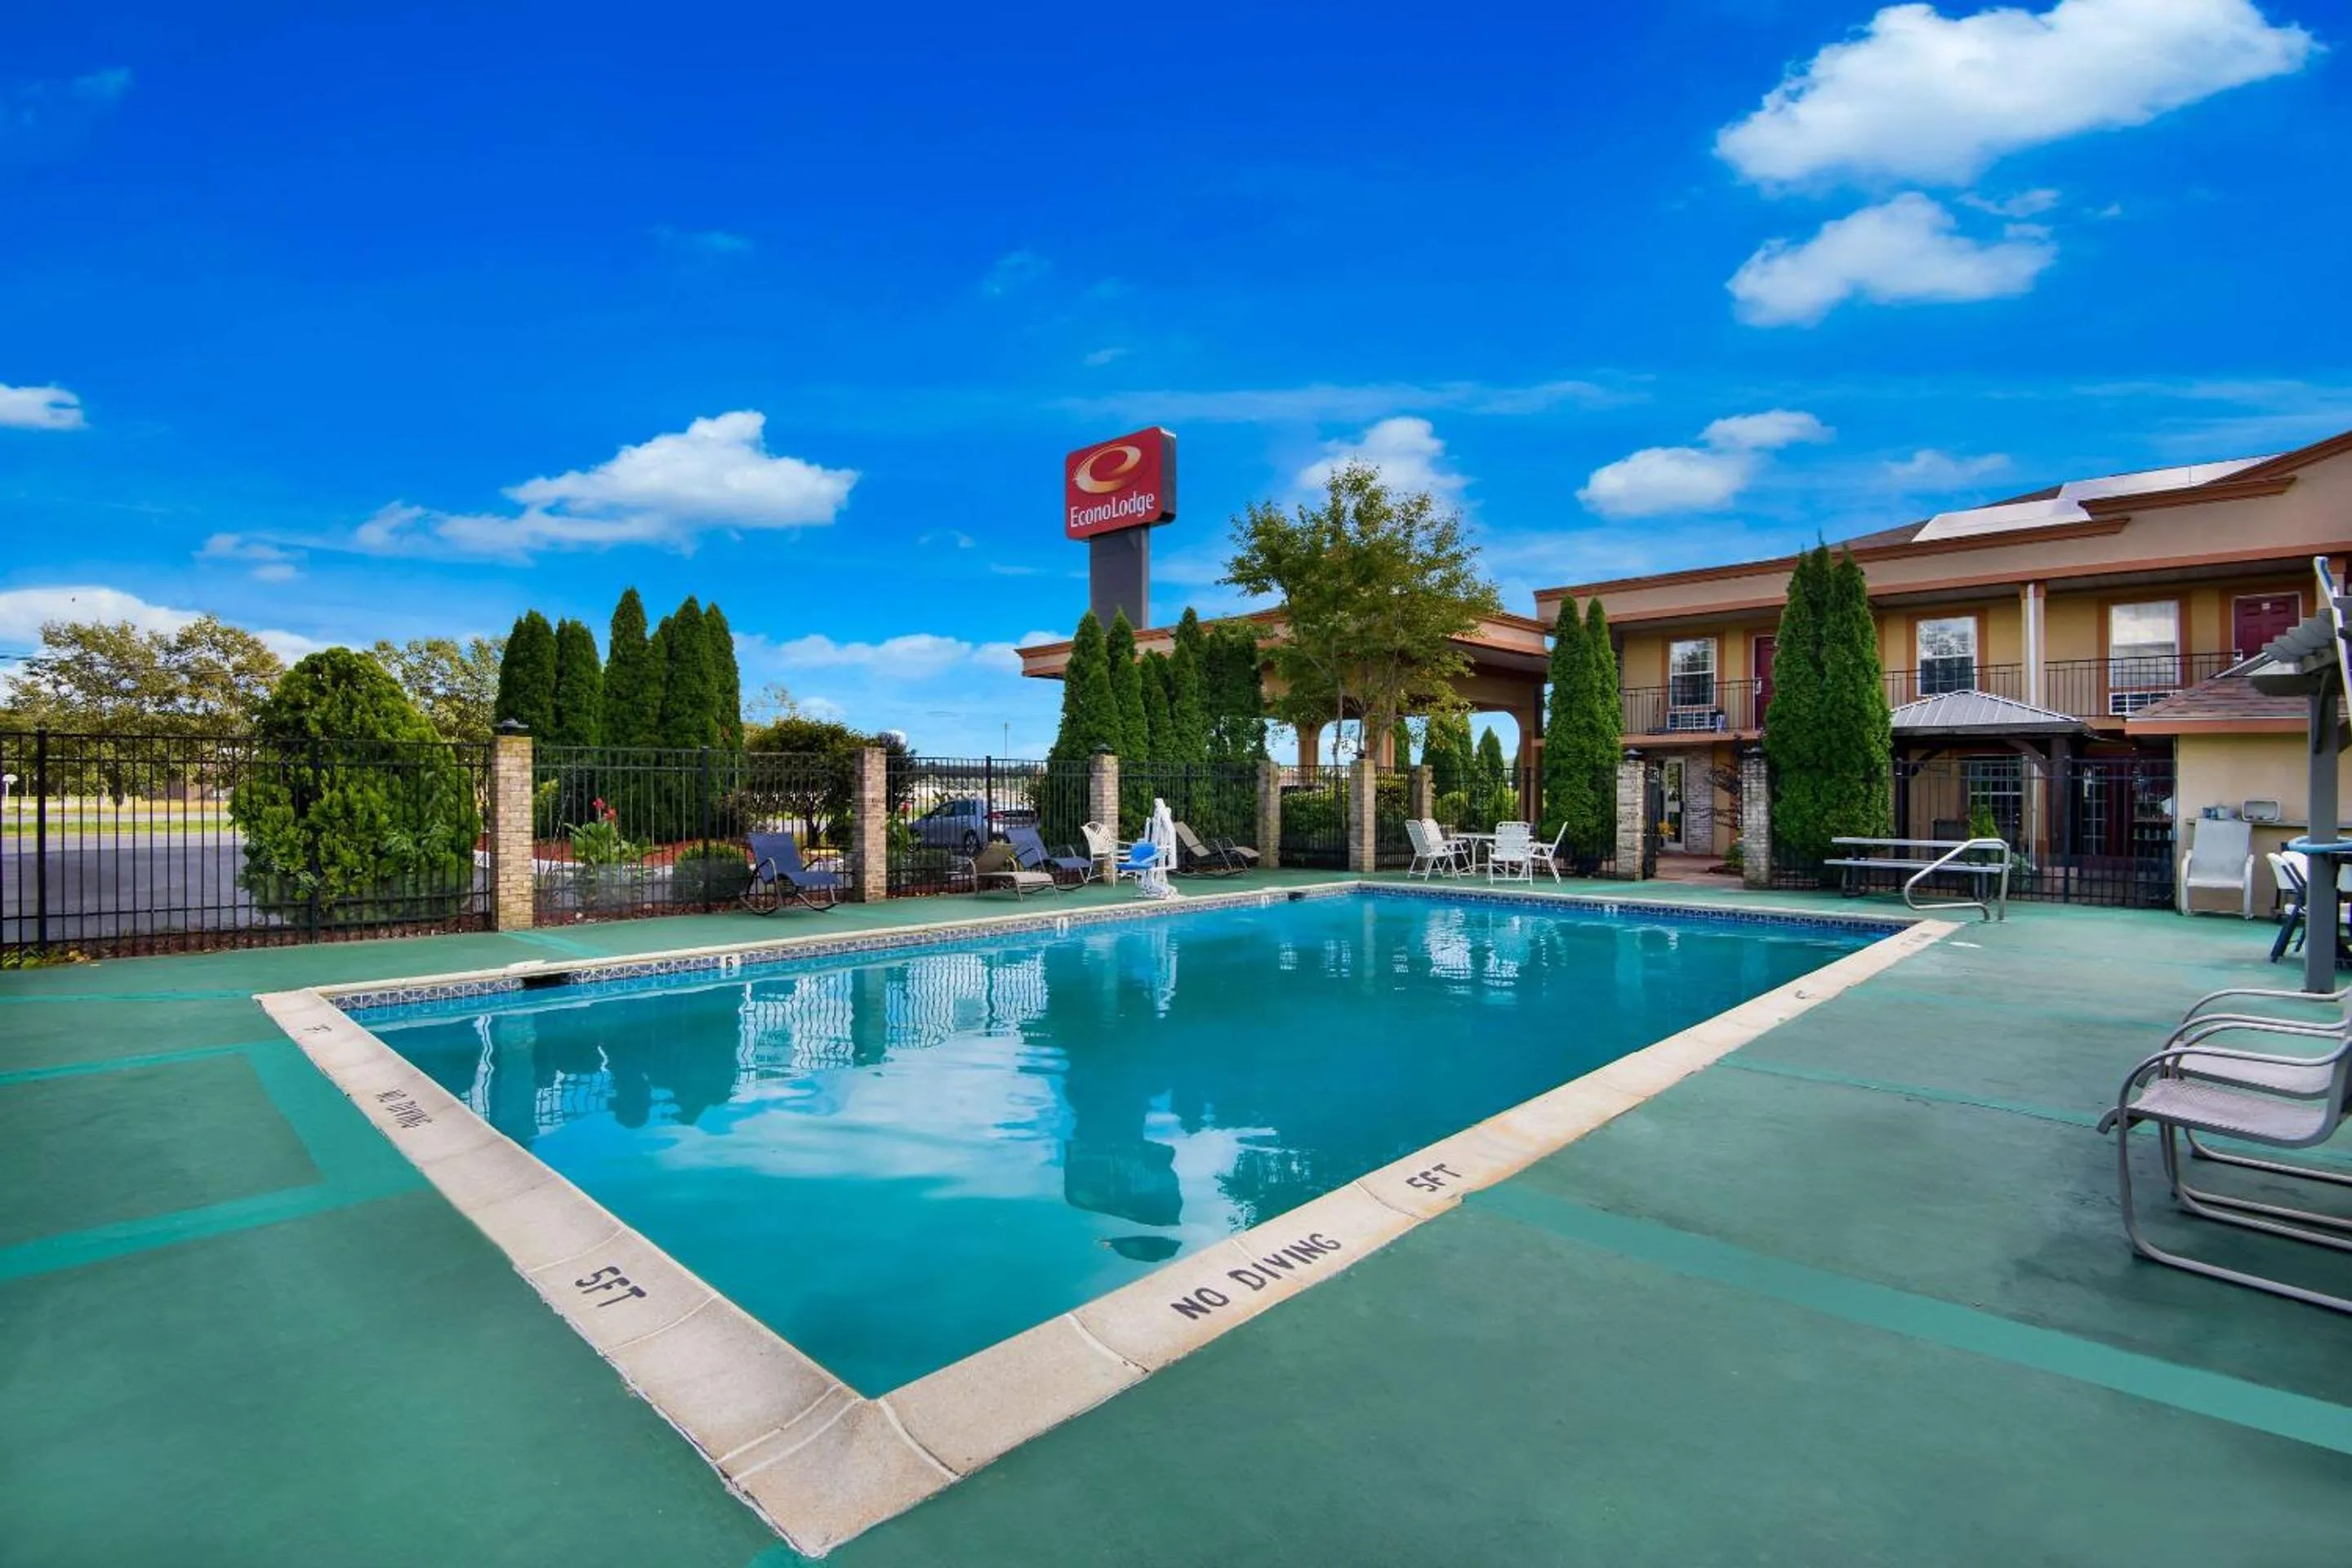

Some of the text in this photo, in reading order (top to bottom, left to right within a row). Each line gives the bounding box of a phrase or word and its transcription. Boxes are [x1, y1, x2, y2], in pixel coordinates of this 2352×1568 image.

[1070, 492, 1155, 528] EconoLodge
[1405, 1163, 1461, 1192] 5FT
[575, 1266, 646, 1307] 5FT
[1169, 1233, 1341, 1320] NO DIVING
